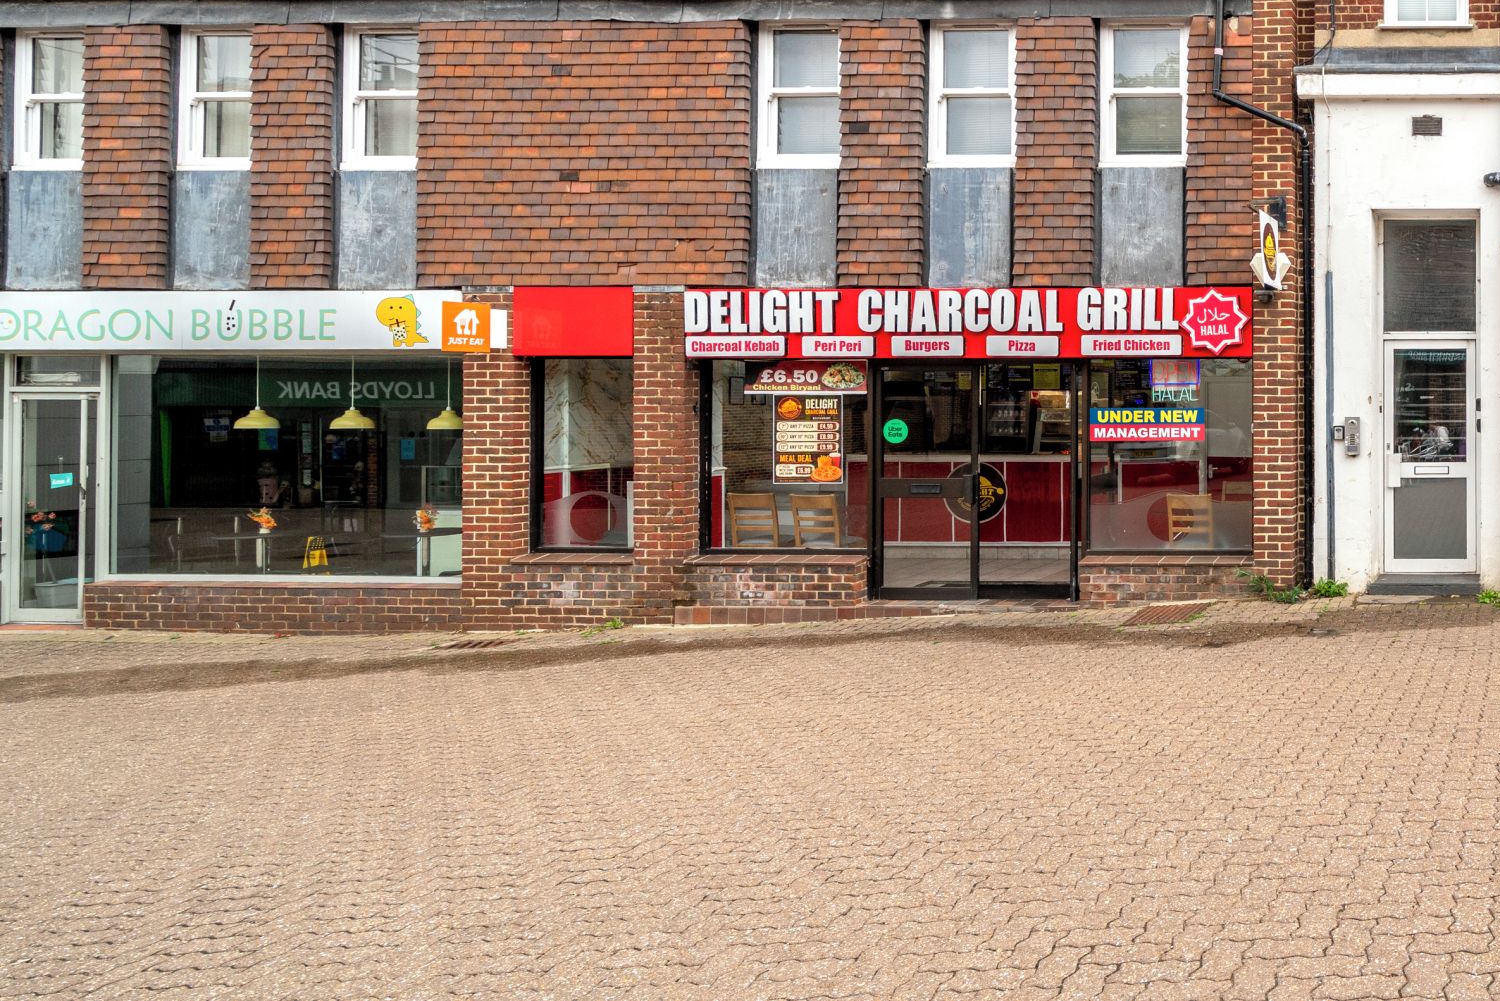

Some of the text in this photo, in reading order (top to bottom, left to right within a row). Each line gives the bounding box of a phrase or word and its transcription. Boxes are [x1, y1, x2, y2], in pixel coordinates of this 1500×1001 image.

[684, 287, 1179, 333] DELIGHT CHARCOAL GRILL
[1197, 308, 1230, 324] حلال
[191, 309, 337, 341] BUBBLE
[1200, 324, 1229, 336] HALAL
[448, 337, 485, 346] JUST EAT
[691, 340, 780, 352] Charcoal Kebab
[814, 340, 862, 352] Peri Peri
[905, 339, 950, 352] Burgers
[1008, 340, 1036, 352] Pizza
[1093, 339, 1170, 351] Fried Chicken
[761, 370, 818, 383] £6.50
[1152, 385, 1199, 402] HALAL
[805, 399, 838, 409] DELIGHT
[1097, 410, 1198, 423] UNDER NEW
[1094, 427, 1200, 438] MANAGEMENT
